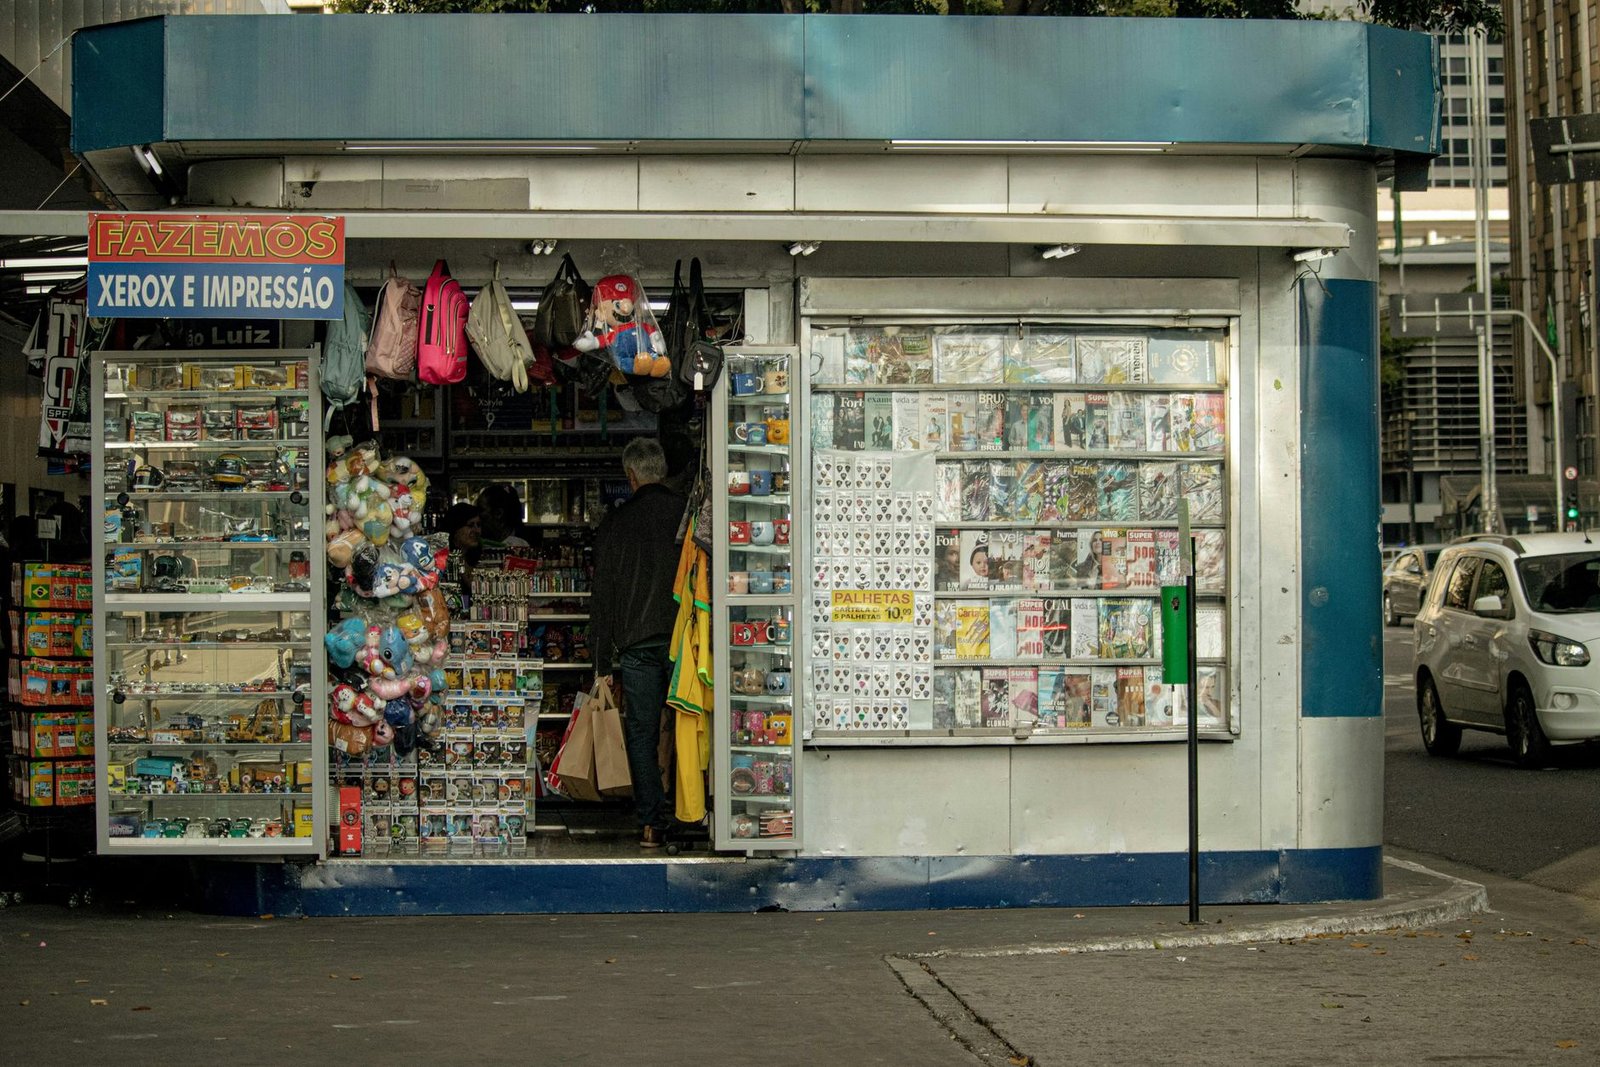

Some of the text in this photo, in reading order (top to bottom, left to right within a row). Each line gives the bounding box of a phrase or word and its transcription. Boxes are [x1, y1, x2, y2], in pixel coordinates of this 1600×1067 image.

[96, 219, 338, 258] FAZEMOS
[98, 267, 334, 310] XEROX E IMPRESSÃO
[211, 325, 271, 345] Luiz
[412, 542, 427, 555] A
[834, 592, 911, 605] PALHETAS
[1118, 668, 1143, 676] SUPER
